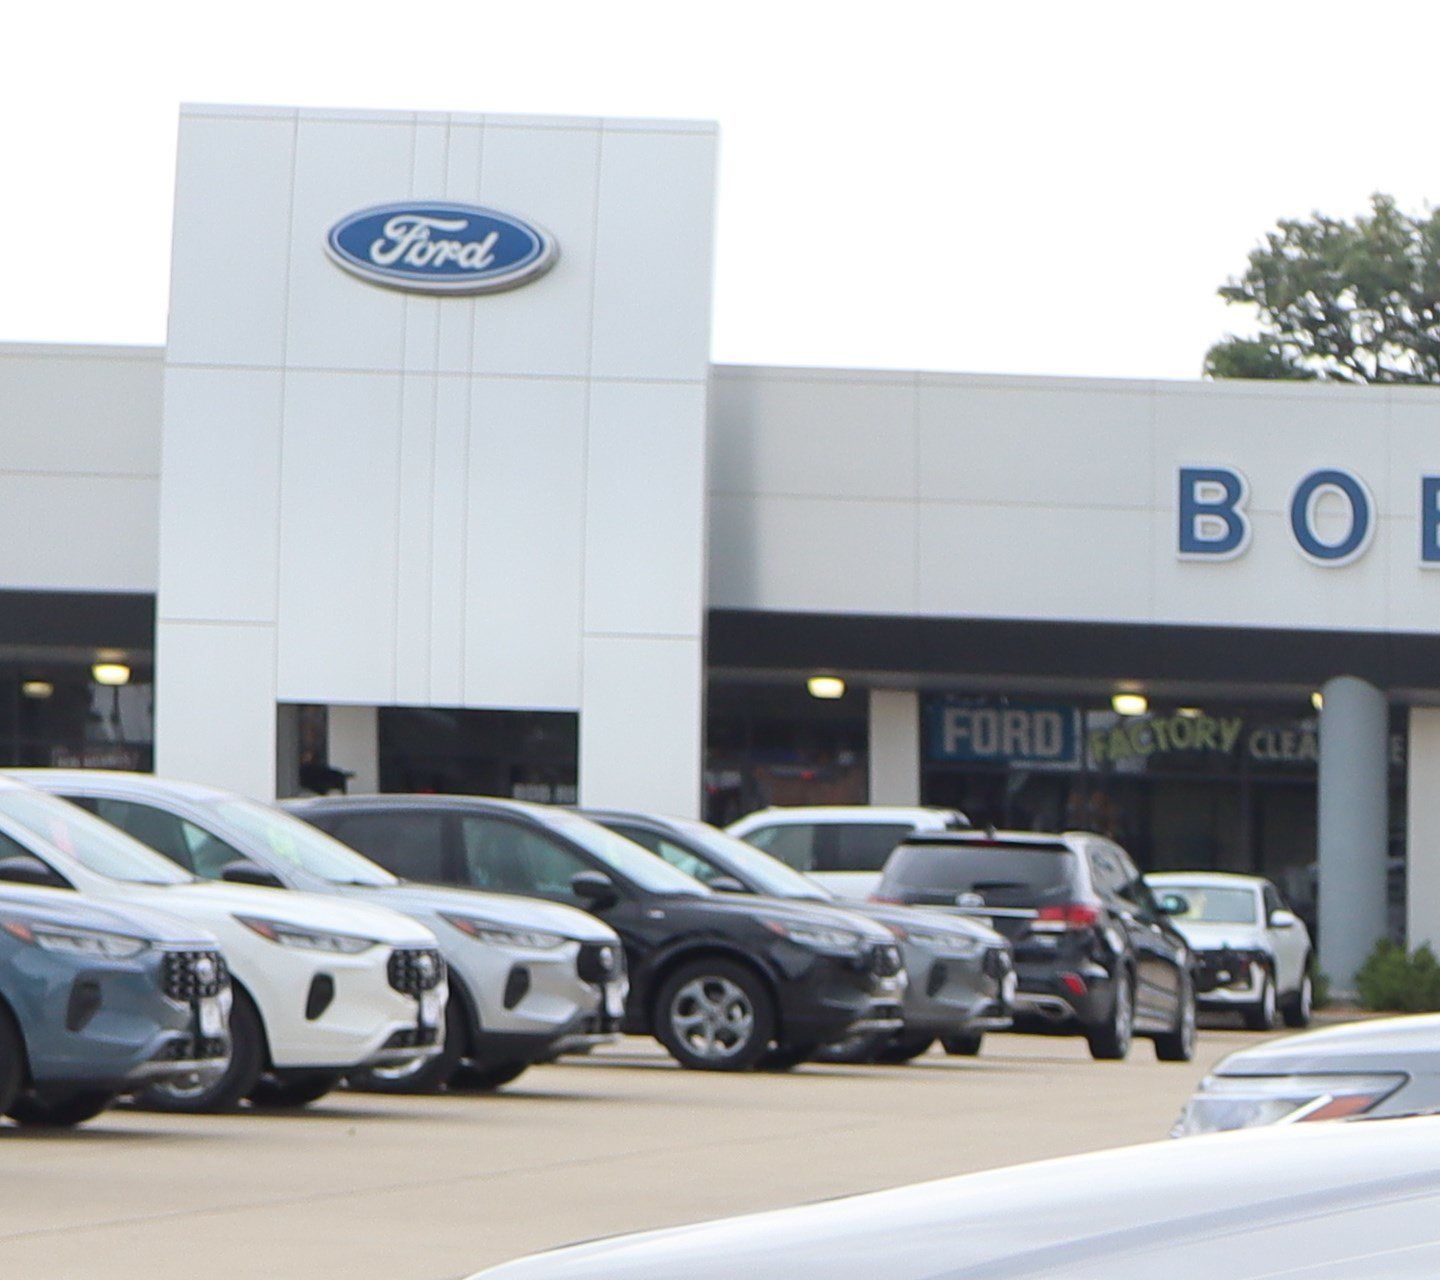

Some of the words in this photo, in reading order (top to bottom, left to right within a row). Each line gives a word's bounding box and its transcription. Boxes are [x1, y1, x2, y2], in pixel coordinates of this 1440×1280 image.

[370, 213, 498, 270] Ford
[944, 707, 1063, 756] FORD
[1089, 715, 1242, 763] FACTORY
